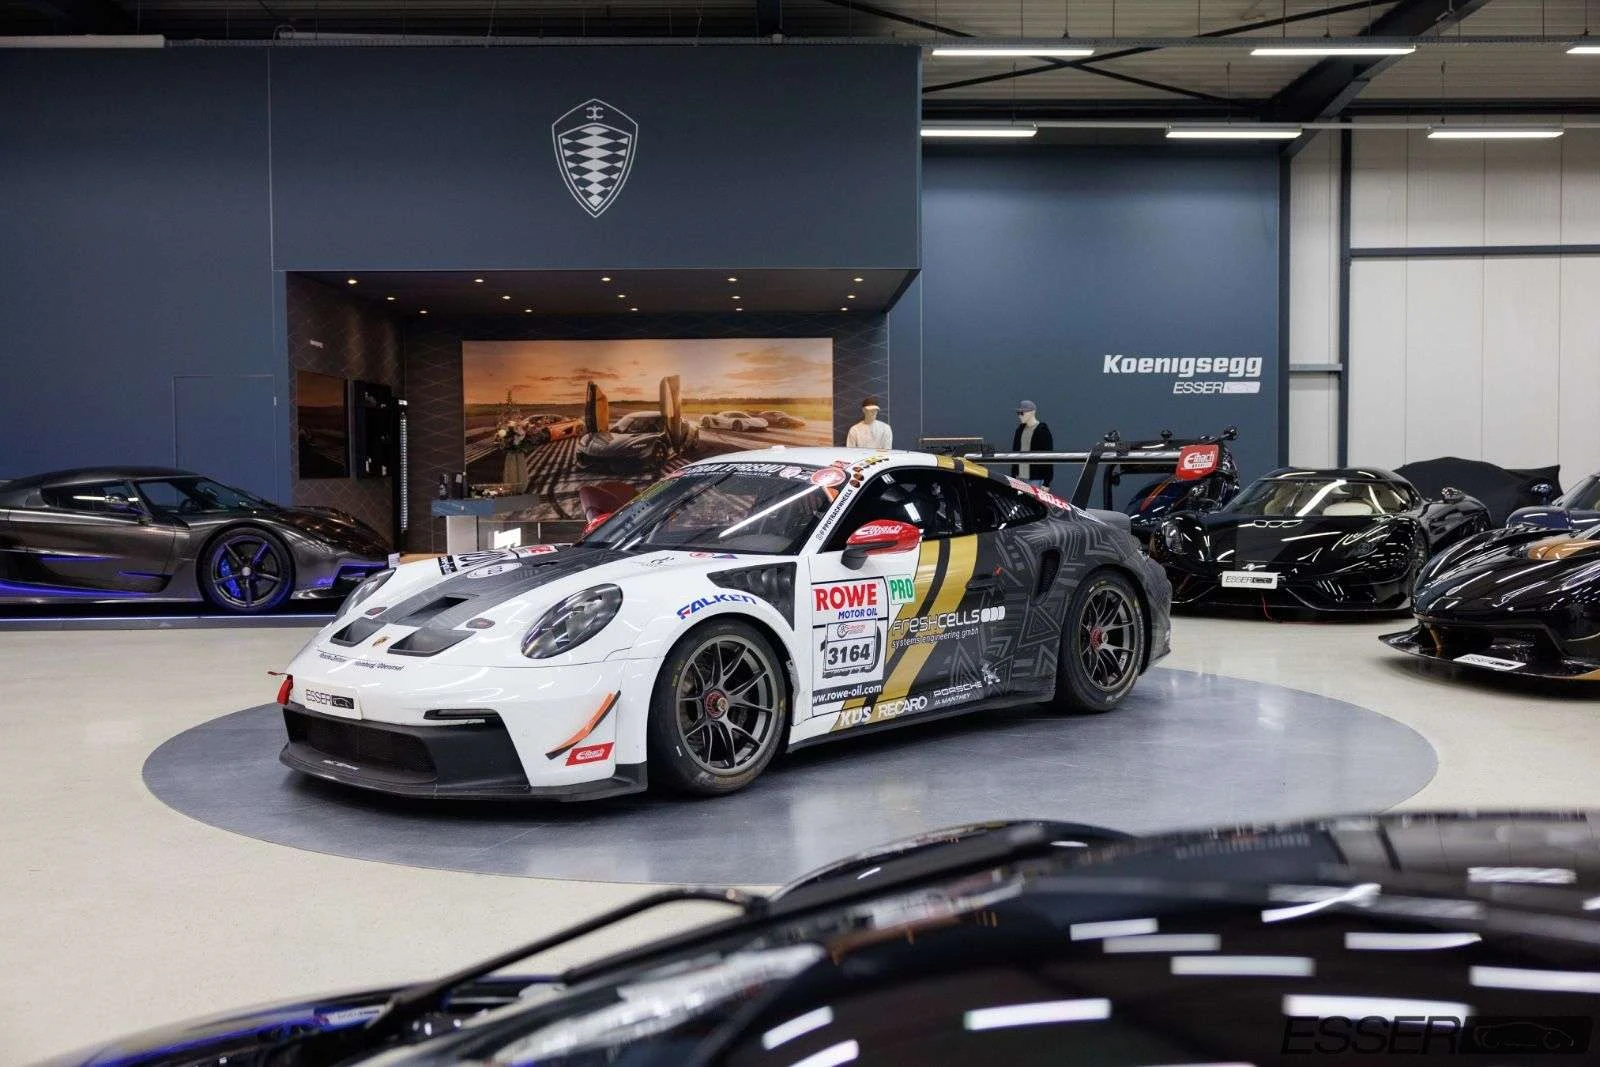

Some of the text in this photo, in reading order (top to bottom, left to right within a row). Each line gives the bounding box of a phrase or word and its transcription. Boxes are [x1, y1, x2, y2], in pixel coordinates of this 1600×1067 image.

[1103, 354, 1263, 377] Koenigsegg
[1173, 381, 1224, 394] ESSER
[814, 583, 877, 612] ROWE
[888, 578, 914, 600] PRO
[676, 594, 757, 620] FALKEN
[838, 609, 878, 620] MOTOR OIL
[827, 643, 871, 665] 3164
[892, 638, 920, 648] systems
[305, 688, 332, 706] ESSER
[934, 681, 983, 698] PORSCHE
[878, 695, 928, 719] RECARO
